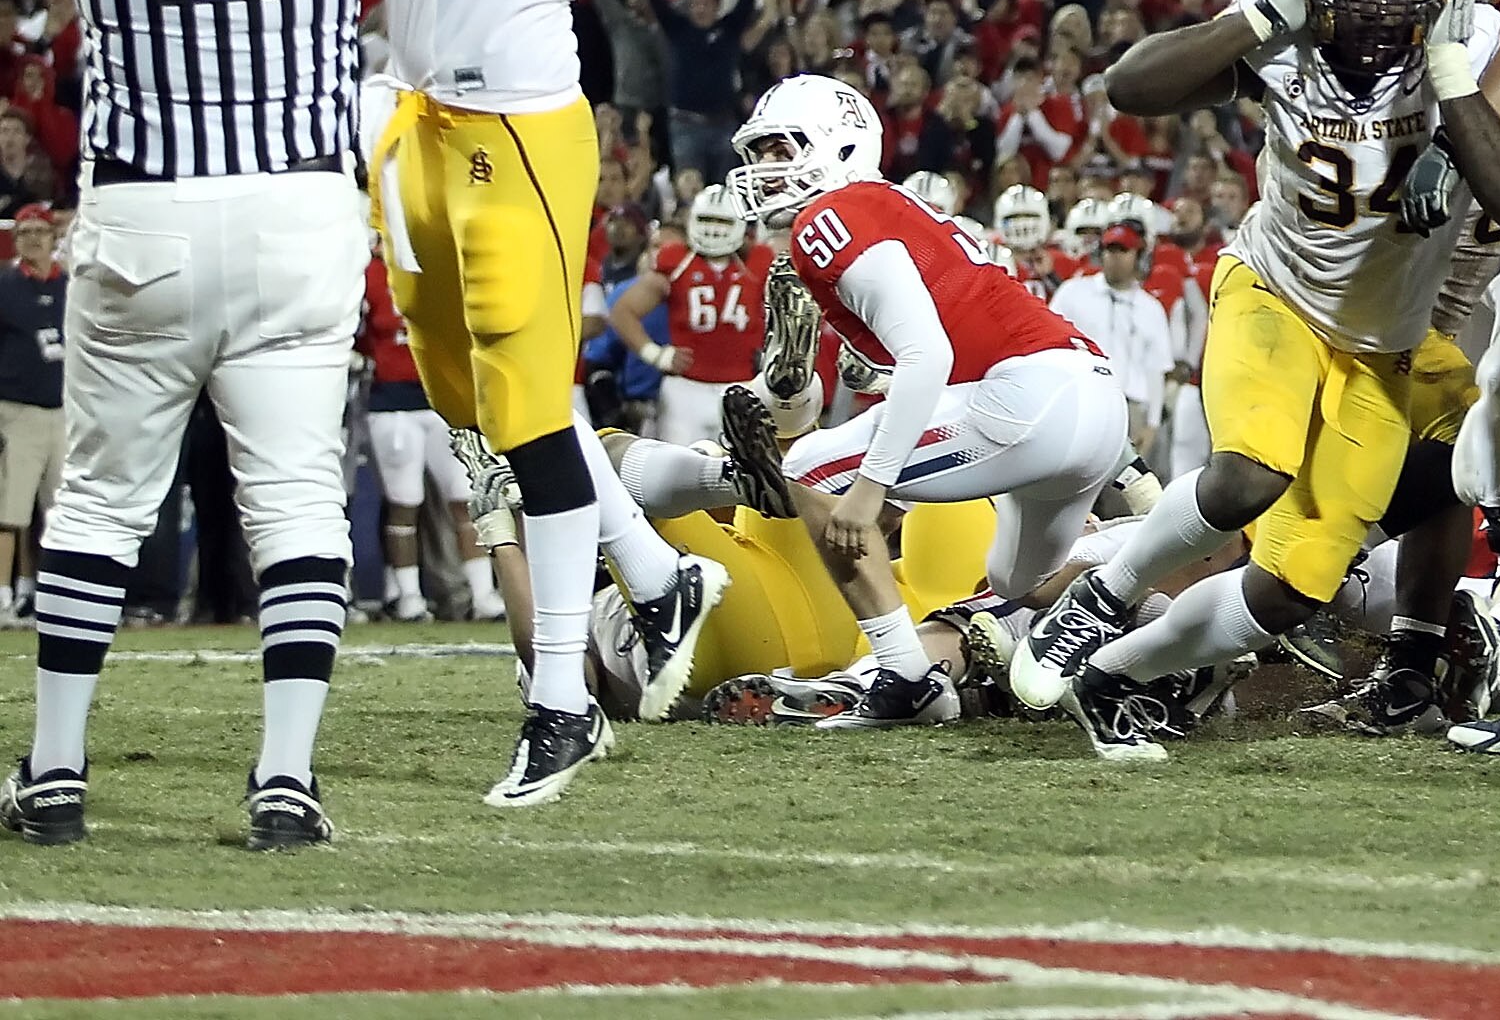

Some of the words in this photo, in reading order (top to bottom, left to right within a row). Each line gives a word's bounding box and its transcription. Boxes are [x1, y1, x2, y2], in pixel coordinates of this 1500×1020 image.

[1300, 112, 1367, 142] ARIZONA
[1371, 111, 1426, 140] STATE
[796, 207, 853, 270] 50
[687, 282, 751, 334] 64
